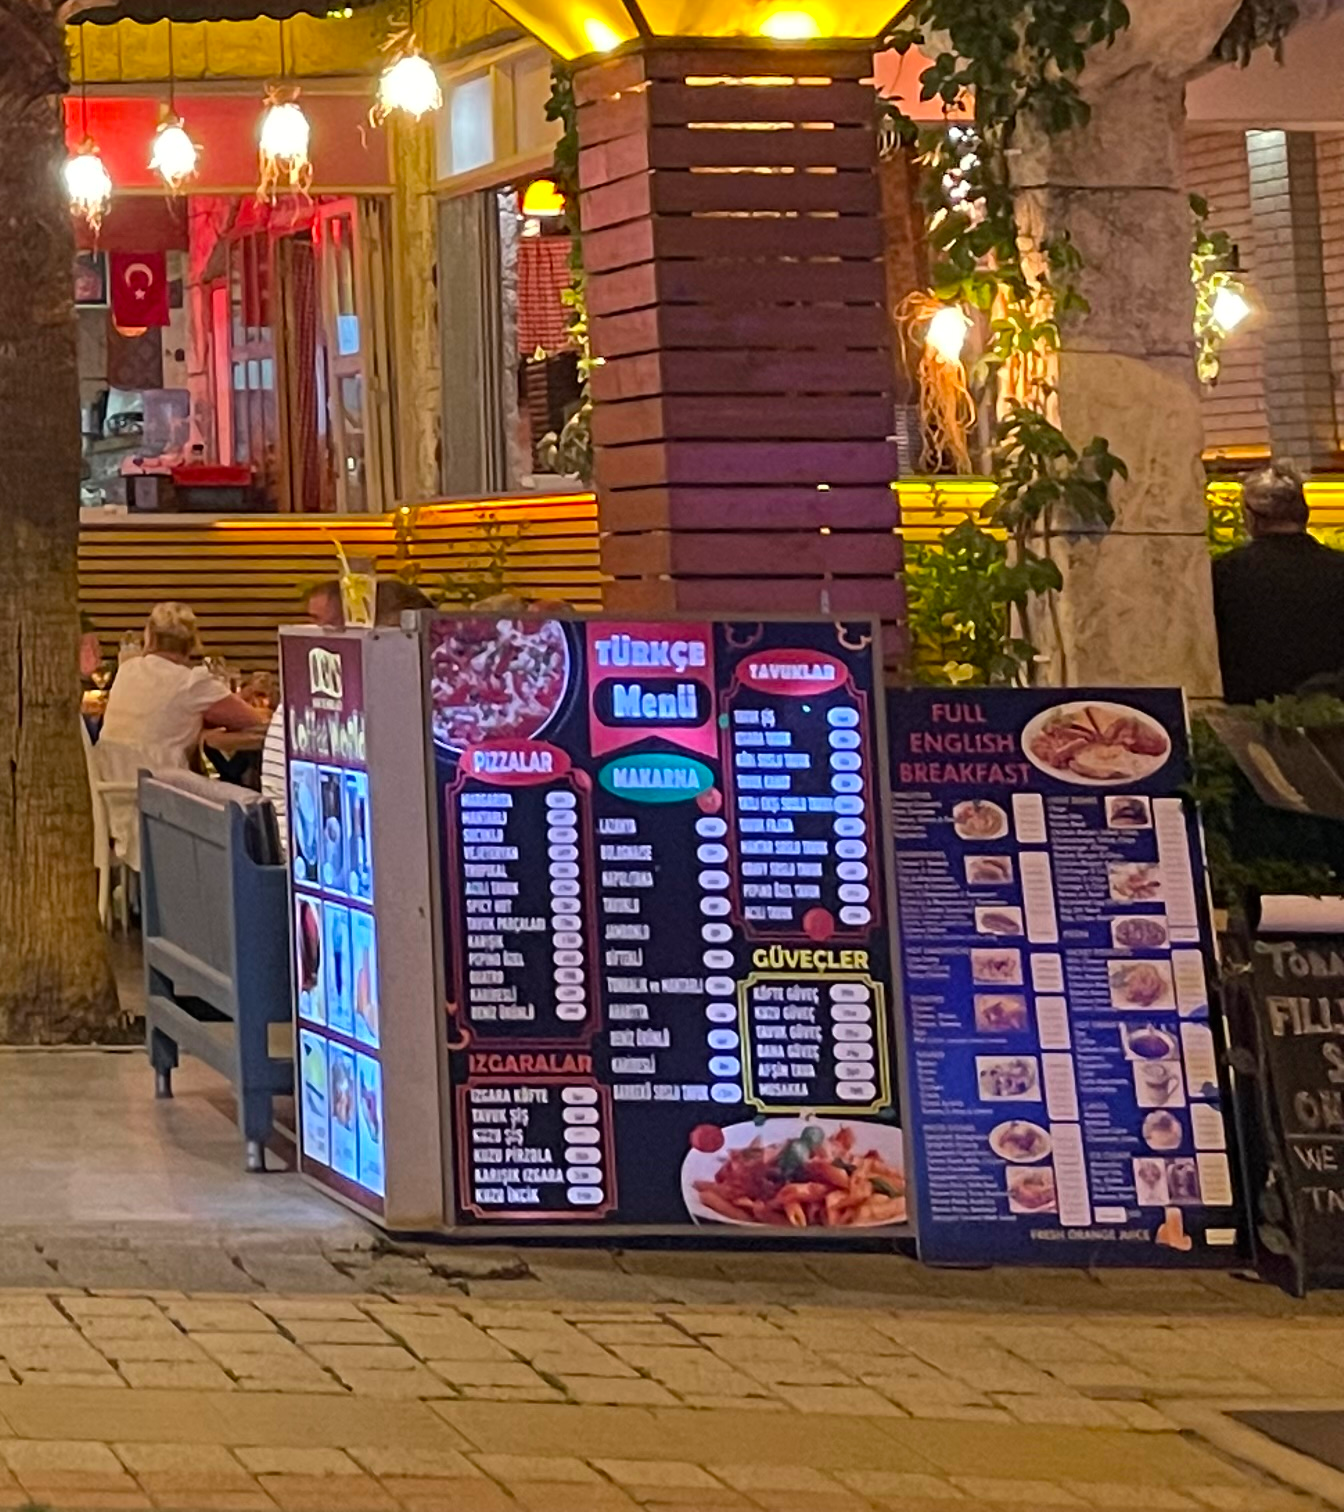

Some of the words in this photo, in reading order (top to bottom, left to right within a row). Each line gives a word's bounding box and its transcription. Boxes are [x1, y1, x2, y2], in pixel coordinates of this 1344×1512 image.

[595, 635, 706, 673] TÜRKÇE
[749, 663, 836, 681] TAVUKLAR
[613, 684, 698, 719] Menü
[932, 703, 988, 723] FULL
[909, 732, 1014, 754] ENGLISH
[613, 768, 701, 789] MAKARNA
[898, 762, 1032, 784] BREAKFAST
[752, 945, 870, 974] GÜVEÇLER
[469, 1053, 593, 1074] IZGARALAR
[1294, 1144, 1338, 1172] WE
